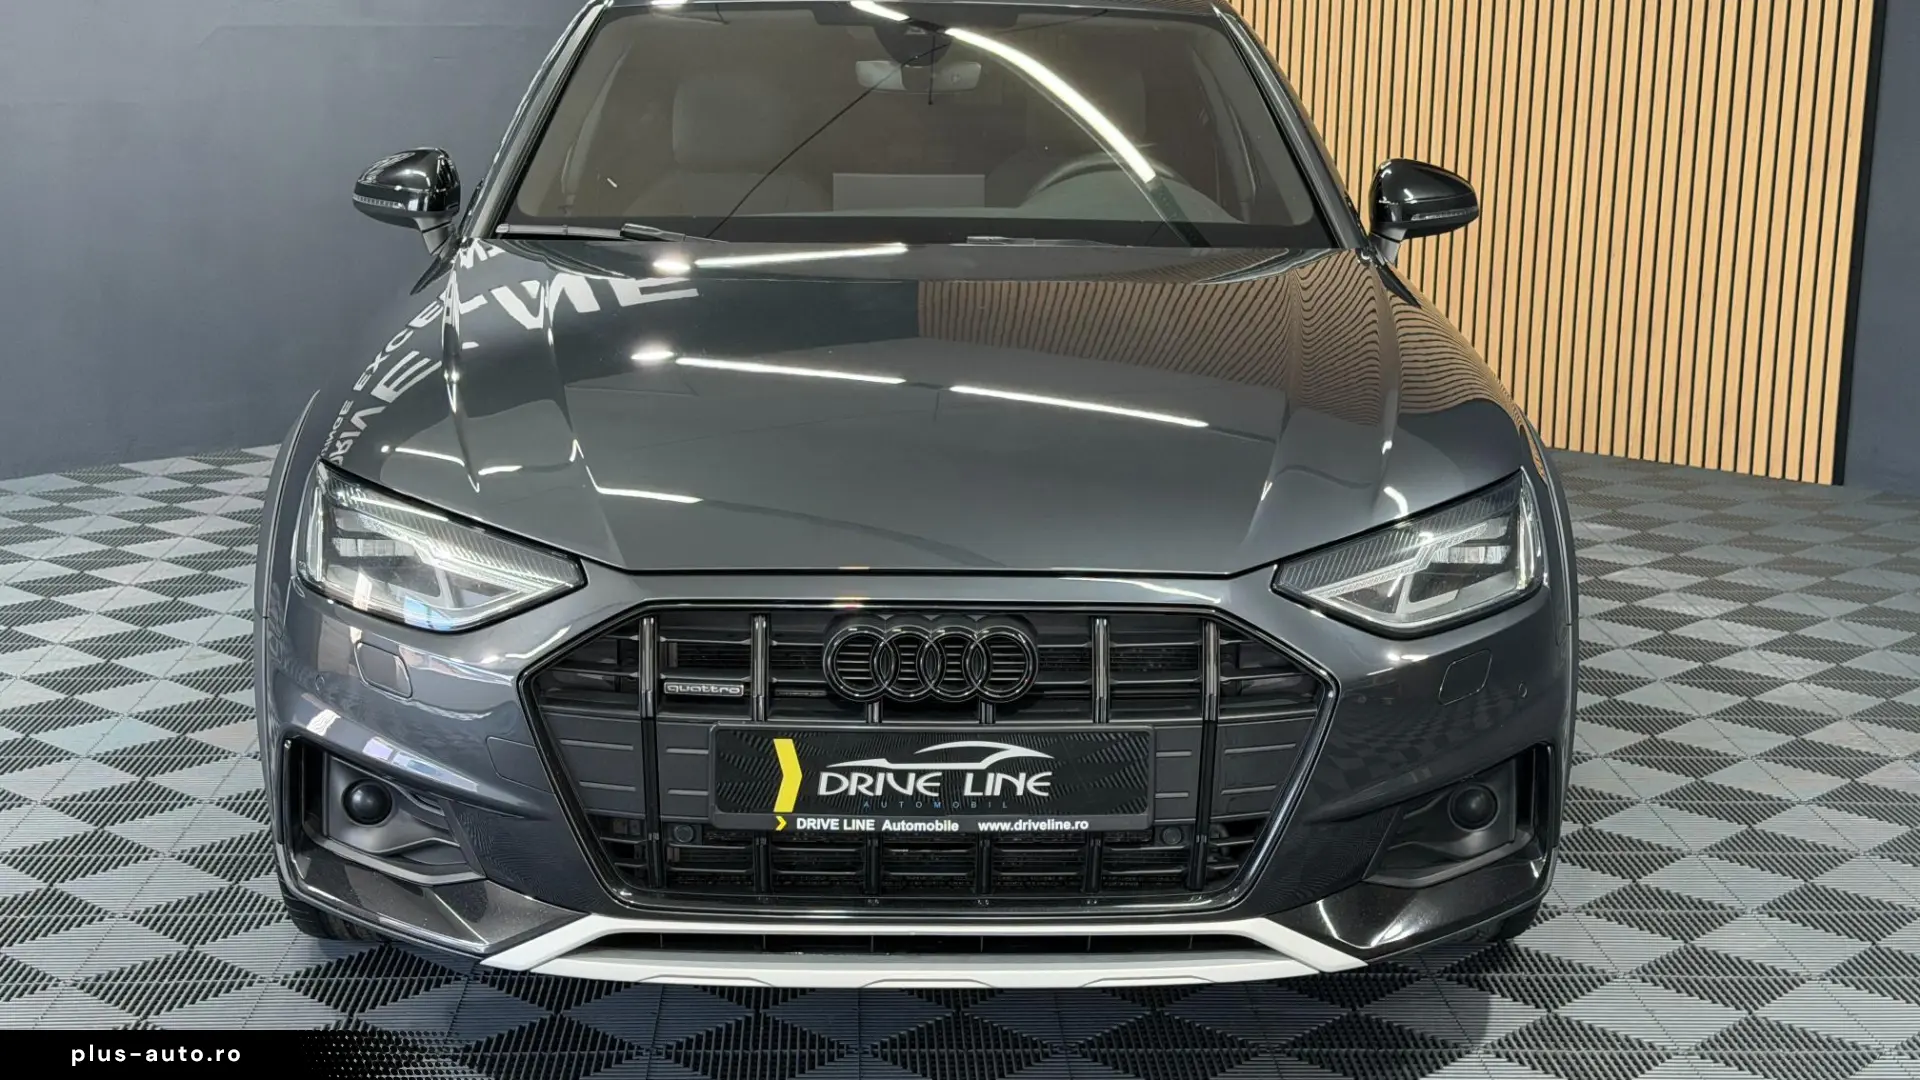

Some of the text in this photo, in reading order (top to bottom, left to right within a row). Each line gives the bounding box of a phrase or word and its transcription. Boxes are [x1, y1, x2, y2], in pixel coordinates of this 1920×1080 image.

[667, 685, 740, 694] quattro
[818, 771, 1052, 797] DRIVE LINE
[863, 801, 1007, 809] AUTOMOBIL
[796, 817, 1089, 832] DRIVE LINE Automobile www.driveline.ro
